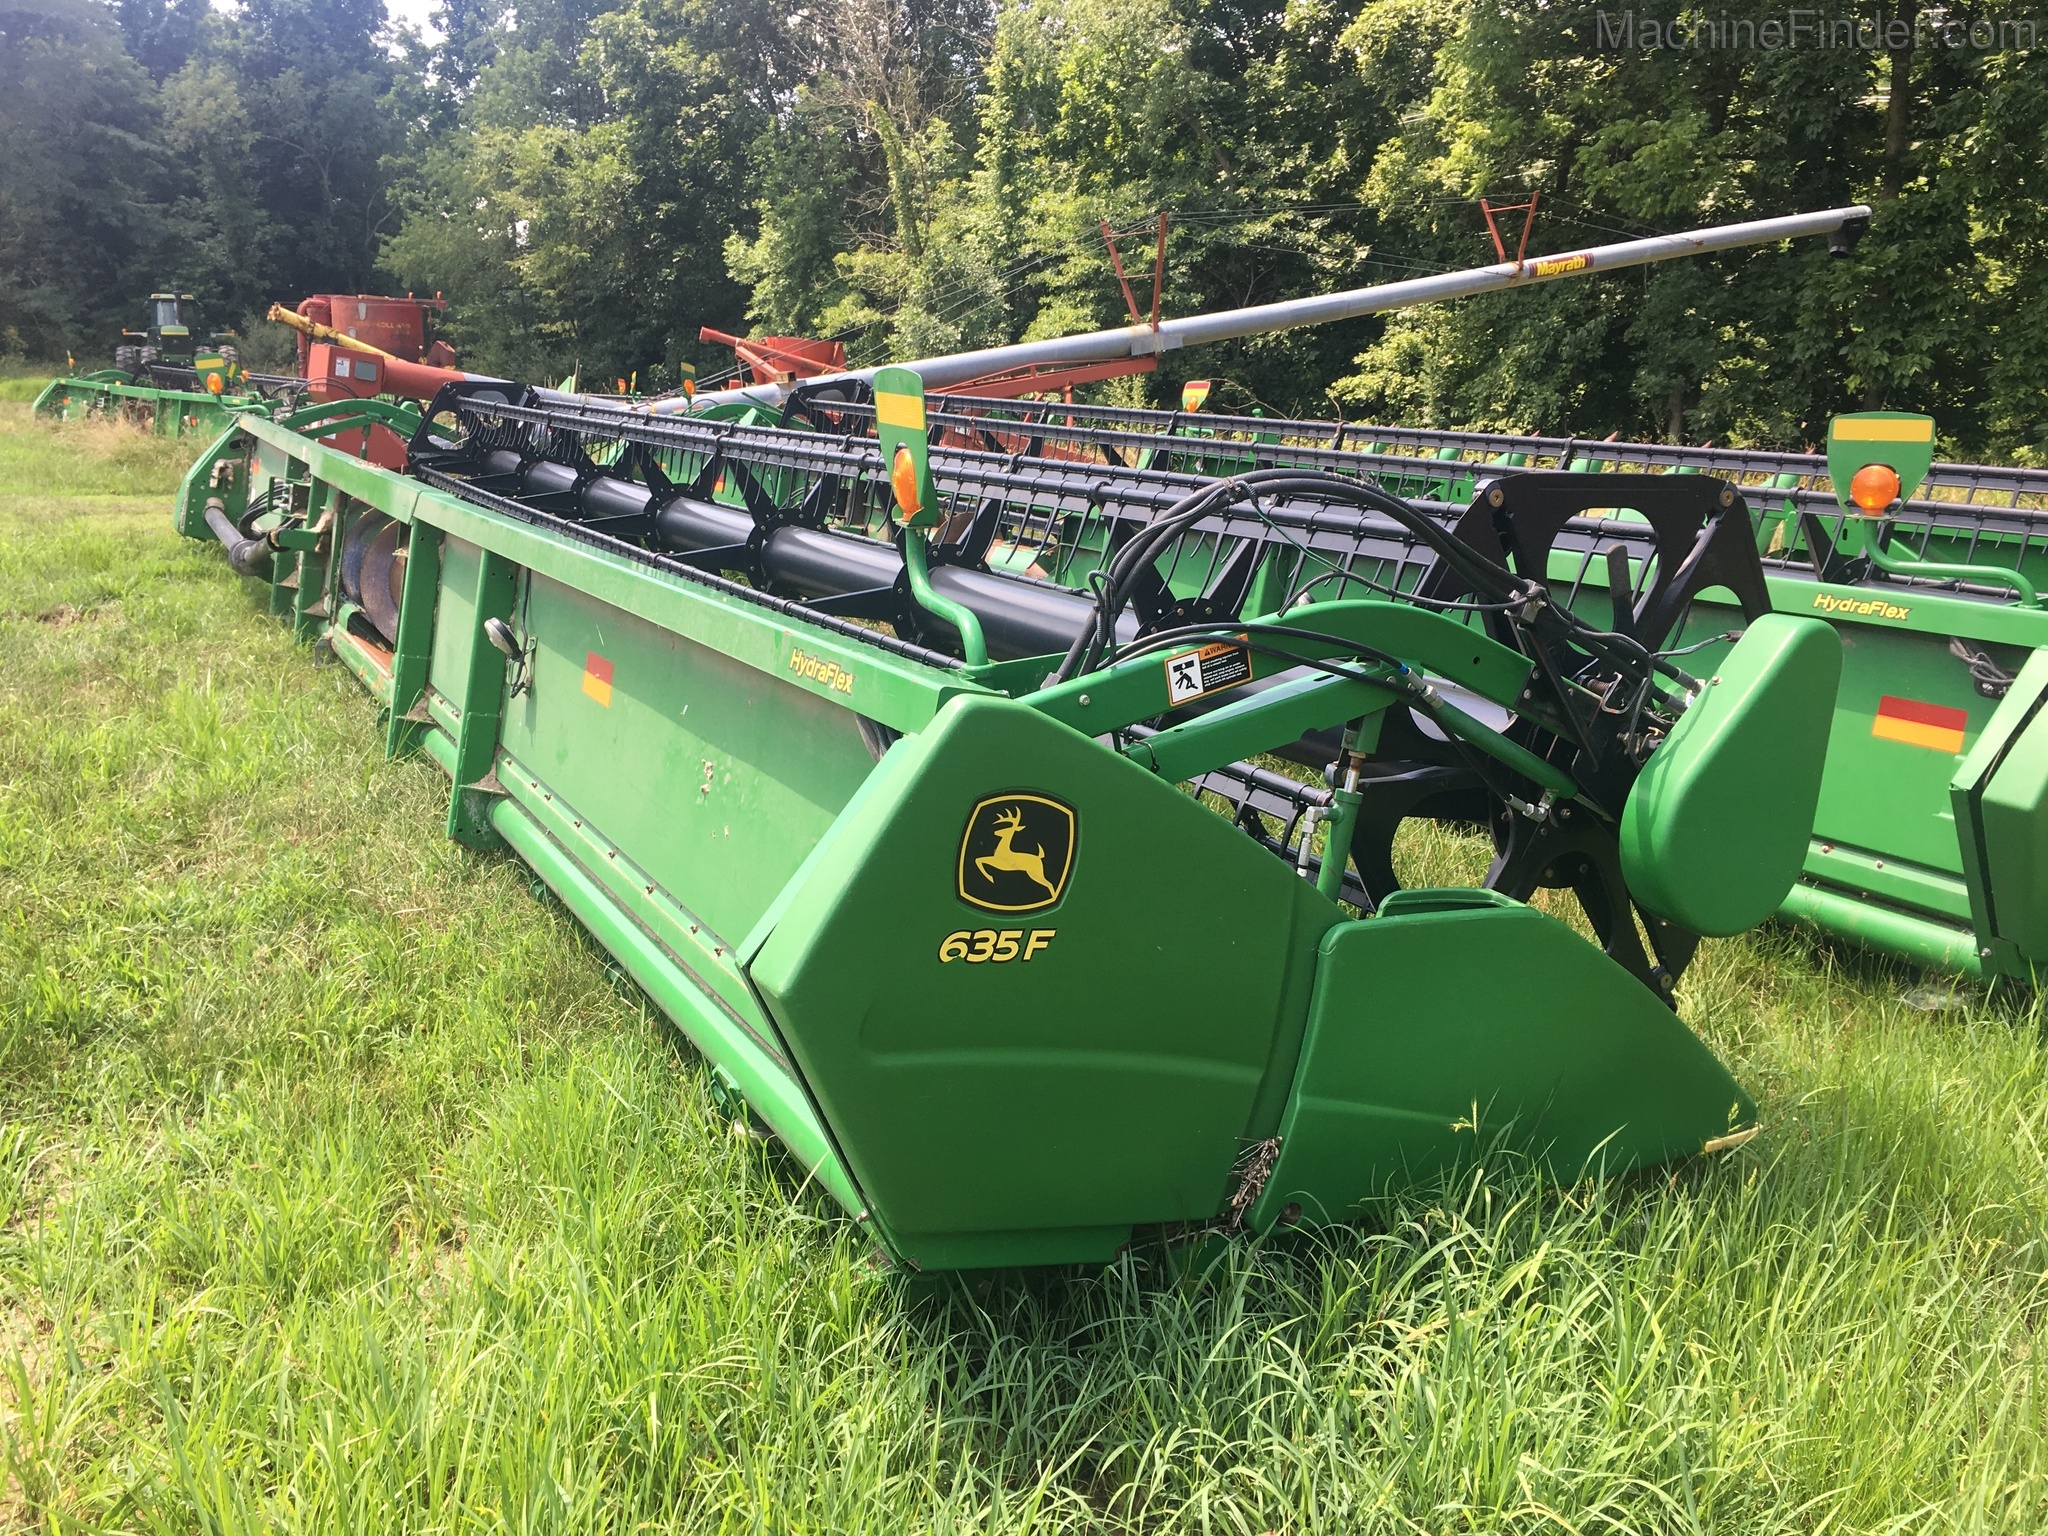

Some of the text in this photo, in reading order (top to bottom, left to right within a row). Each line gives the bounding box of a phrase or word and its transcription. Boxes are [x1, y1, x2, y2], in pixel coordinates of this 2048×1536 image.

[1537, 256, 1586, 276] Mayrath
[1813, 593, 1911, 620] HydraFlex
[789, 647, 855, 695] HydraFlex
